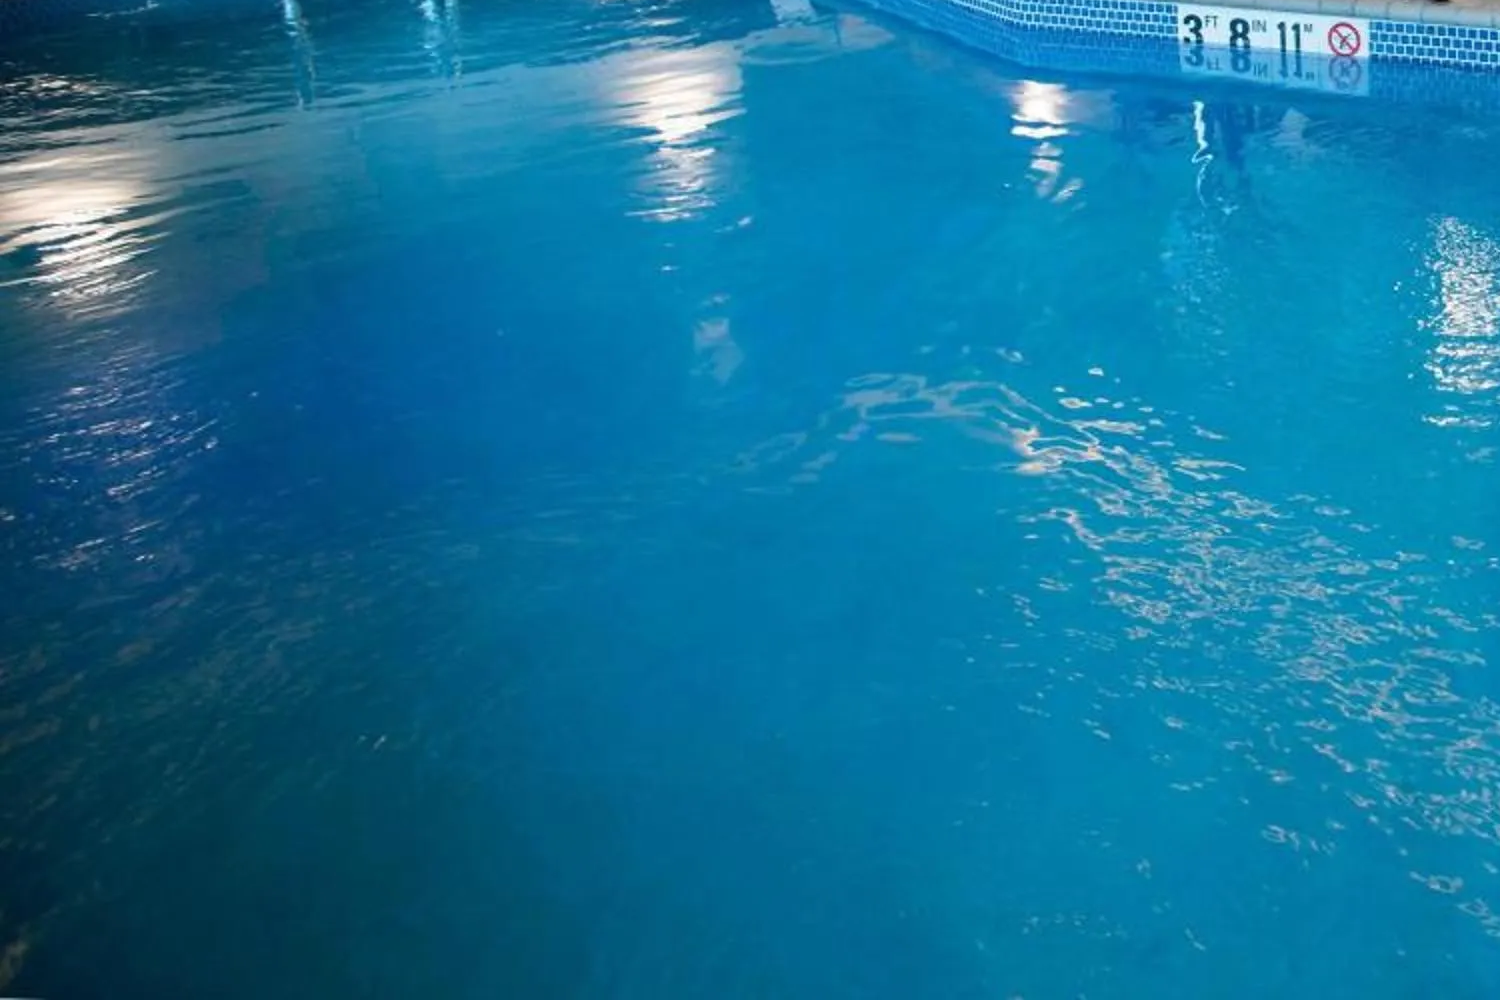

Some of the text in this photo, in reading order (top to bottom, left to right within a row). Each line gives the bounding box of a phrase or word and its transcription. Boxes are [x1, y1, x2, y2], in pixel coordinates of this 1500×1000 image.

[1183, 13, 1204, 44] 3
[1205, 15, 1218, 28] FT
[1229, 18, 1250, 49] 8
[1252, 20, 1267, 33] IN
